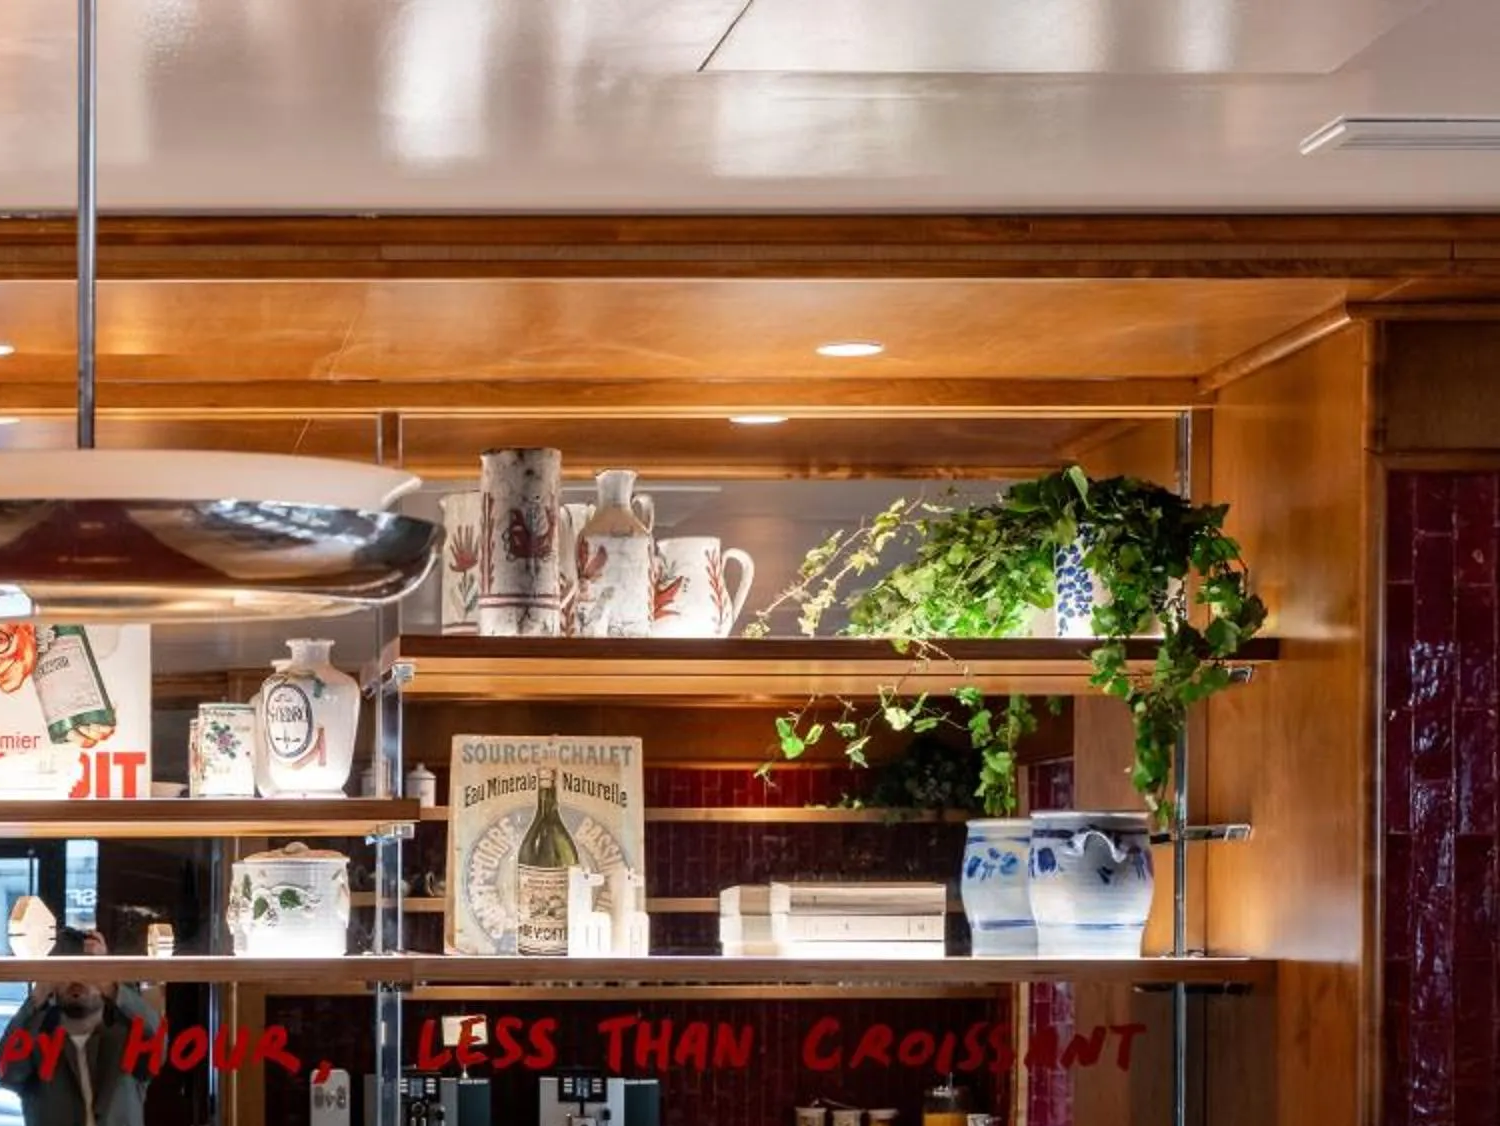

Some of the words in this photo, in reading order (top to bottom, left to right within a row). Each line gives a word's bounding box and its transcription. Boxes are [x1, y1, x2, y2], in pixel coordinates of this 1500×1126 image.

[462, 743, 541, 764] SOURCE
[559, 744, 632, 766] CHALET
[563, 772, 627, 808] Naturelle
[418, 1015, 560, 1073] LESS
[599, 1016, 755, 1073] THAN
[802, 1020, 1148, 1074] CROISSANT
